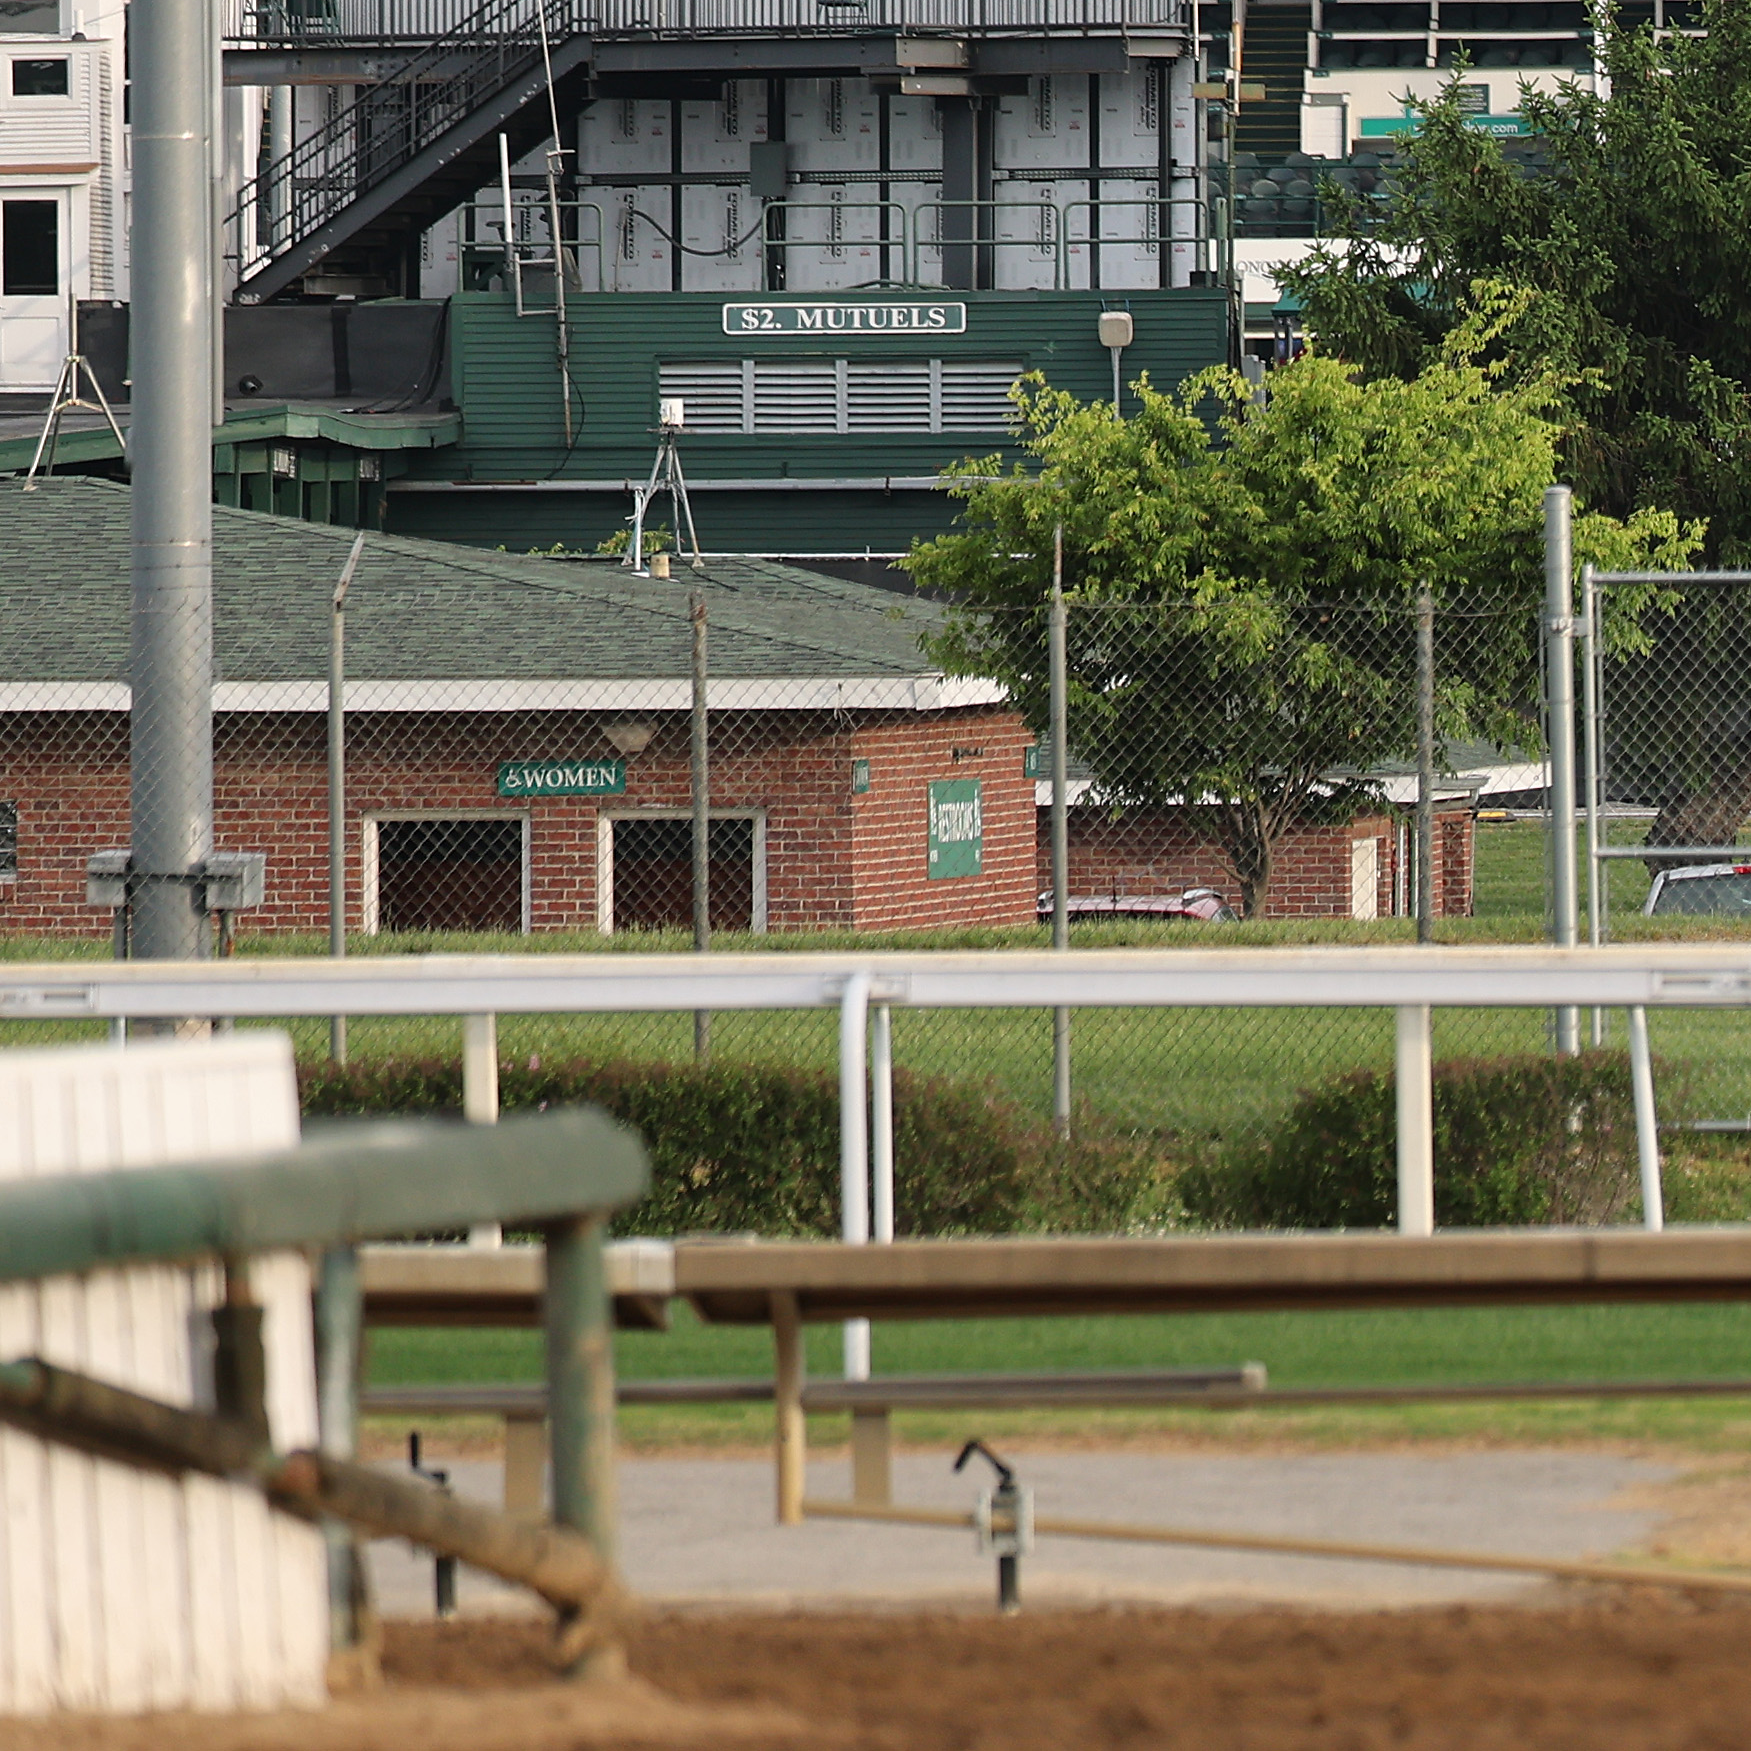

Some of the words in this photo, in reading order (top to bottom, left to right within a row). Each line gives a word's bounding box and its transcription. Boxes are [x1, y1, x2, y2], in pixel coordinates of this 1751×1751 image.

[741, 307, 783, 330] $2.
[796, 307, 946, 329] MUTUELS
[521, 767, 617, 788] WOMEN
